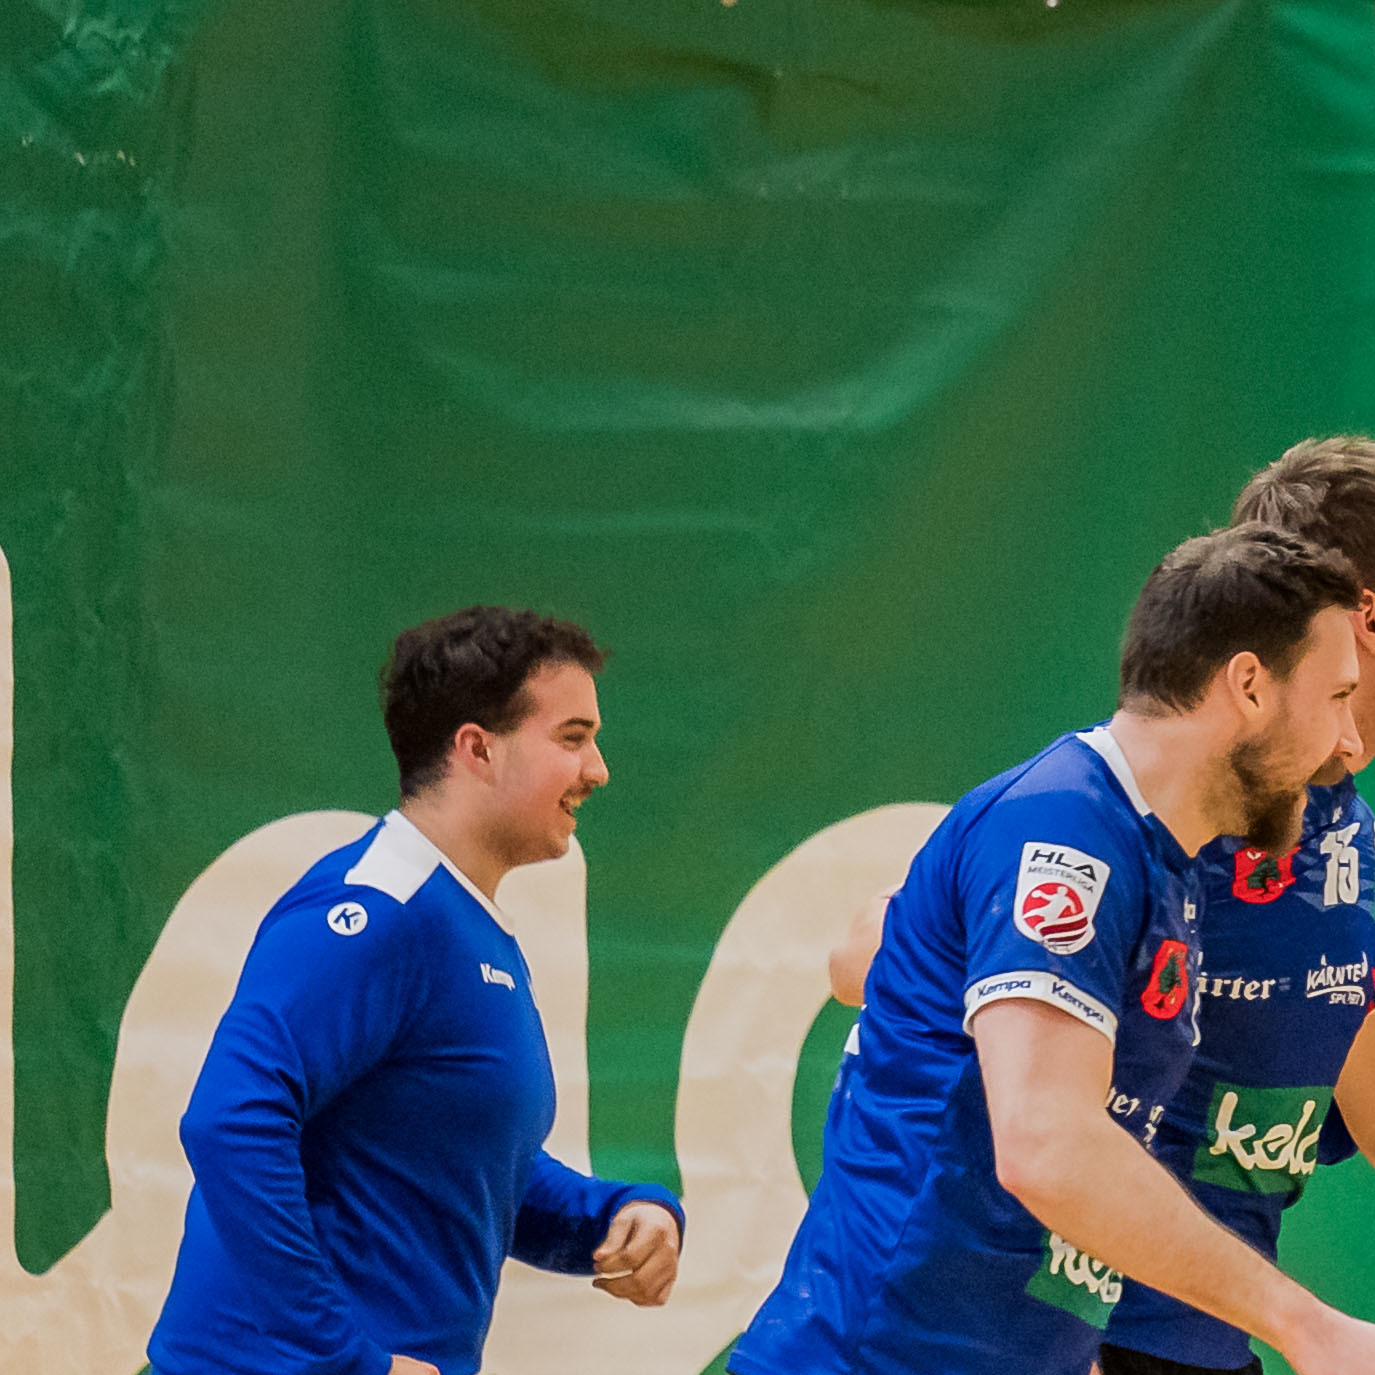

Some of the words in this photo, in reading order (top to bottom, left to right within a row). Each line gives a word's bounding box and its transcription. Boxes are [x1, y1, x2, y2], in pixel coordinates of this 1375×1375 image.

[1031, 849, 1097, 882] HLA
[977, 979, 1032, 999] Kempa
[1198, 972, 1276, 1000] irter
[1051, 981, 1105, 1023] Kempa
